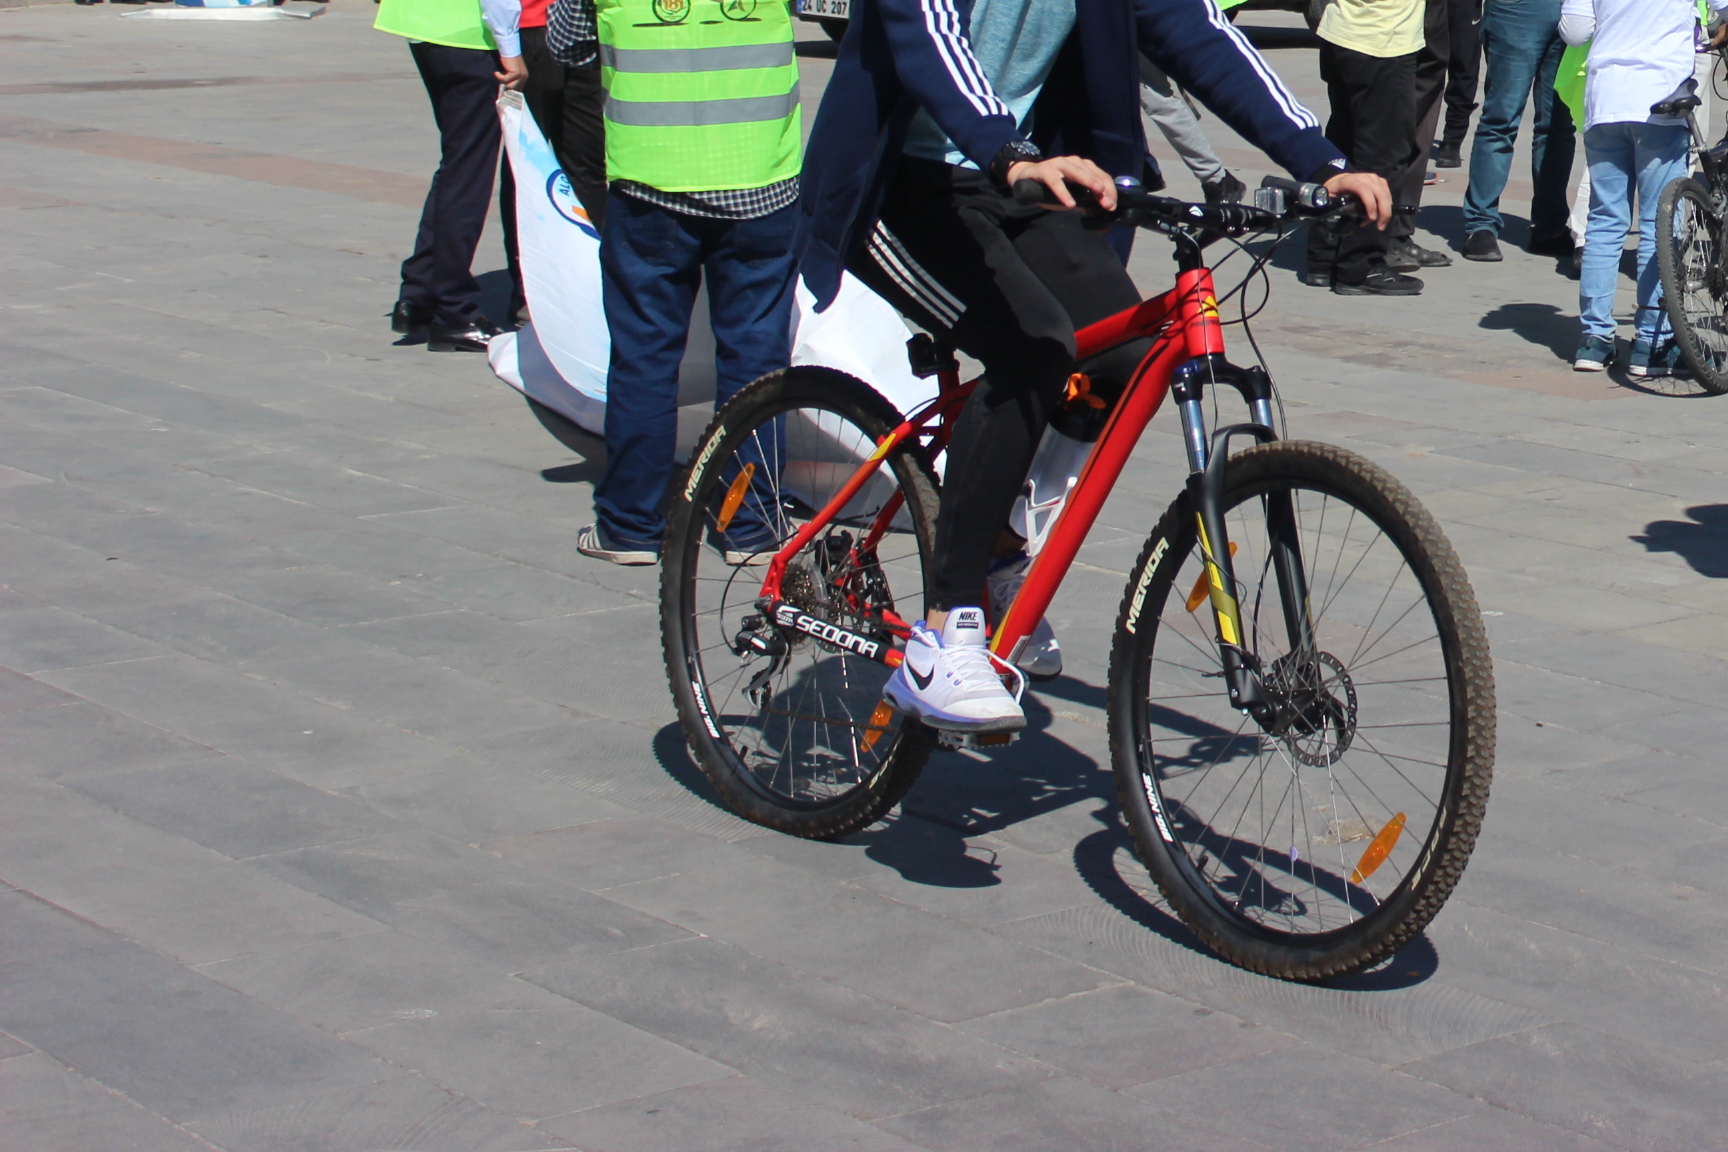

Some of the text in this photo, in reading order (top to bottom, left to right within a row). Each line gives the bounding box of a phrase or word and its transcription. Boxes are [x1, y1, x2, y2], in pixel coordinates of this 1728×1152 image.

[816, 0, 827, 13] UC
[831, 1, 847, 15] 207
[684, 424, 727, 503] MERIDA
[1125, 536, 1170, 635] MERIDA
[795, 614, 879, 658] SEDONA
[958, 611, 978, 621] NIKE
